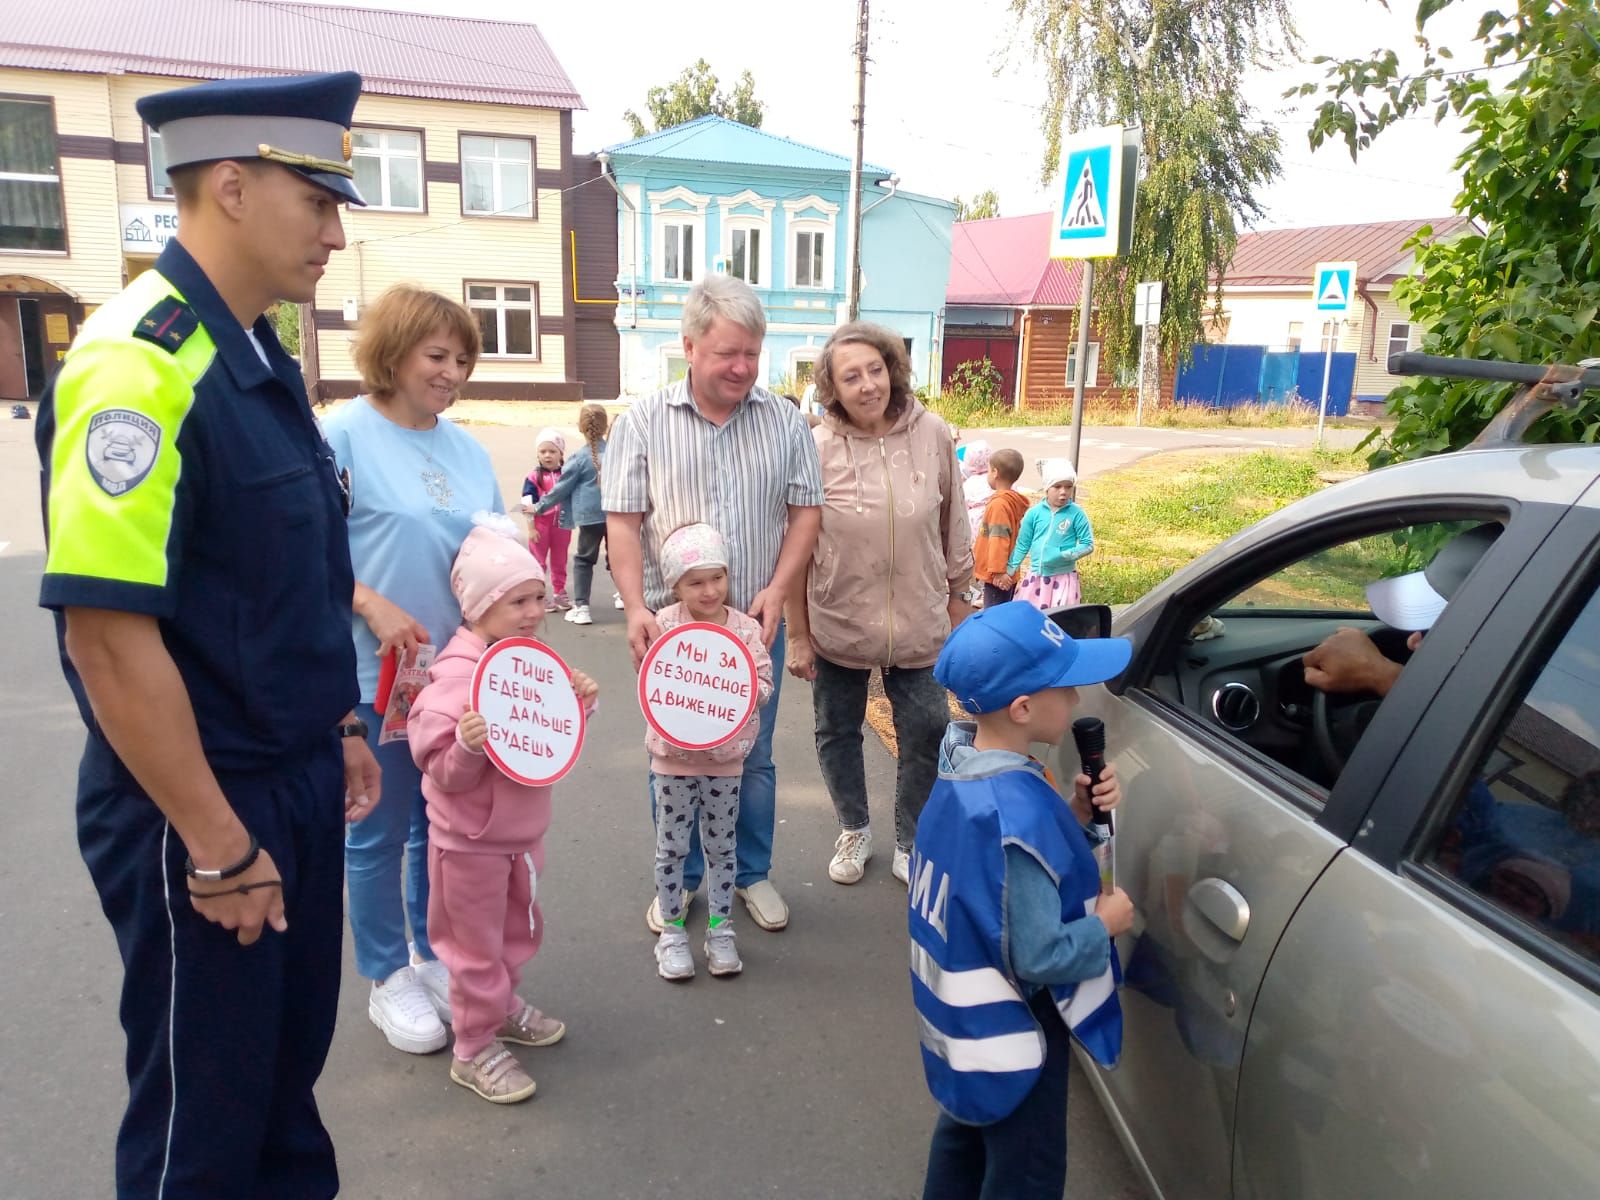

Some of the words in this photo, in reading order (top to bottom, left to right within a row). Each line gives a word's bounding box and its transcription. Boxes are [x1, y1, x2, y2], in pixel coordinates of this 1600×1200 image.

[94, 413, 157, 437] ПОЛИЦИЯ
[511, 656, 554, 684] ТИШЕ
[719, 652, 737, 669] ЗА
[489, 673, 545, 707] ЕДЕШЬ,
[654, 661, 749, 697] БЕЗОПАСНОЕ
[509, 704, 572, 735] ДАЛЬШЕ
[649, 688, 736, 722] ДВИЖЕНИЕ
[490, 723, 554, 758] БУДЕШЬ
